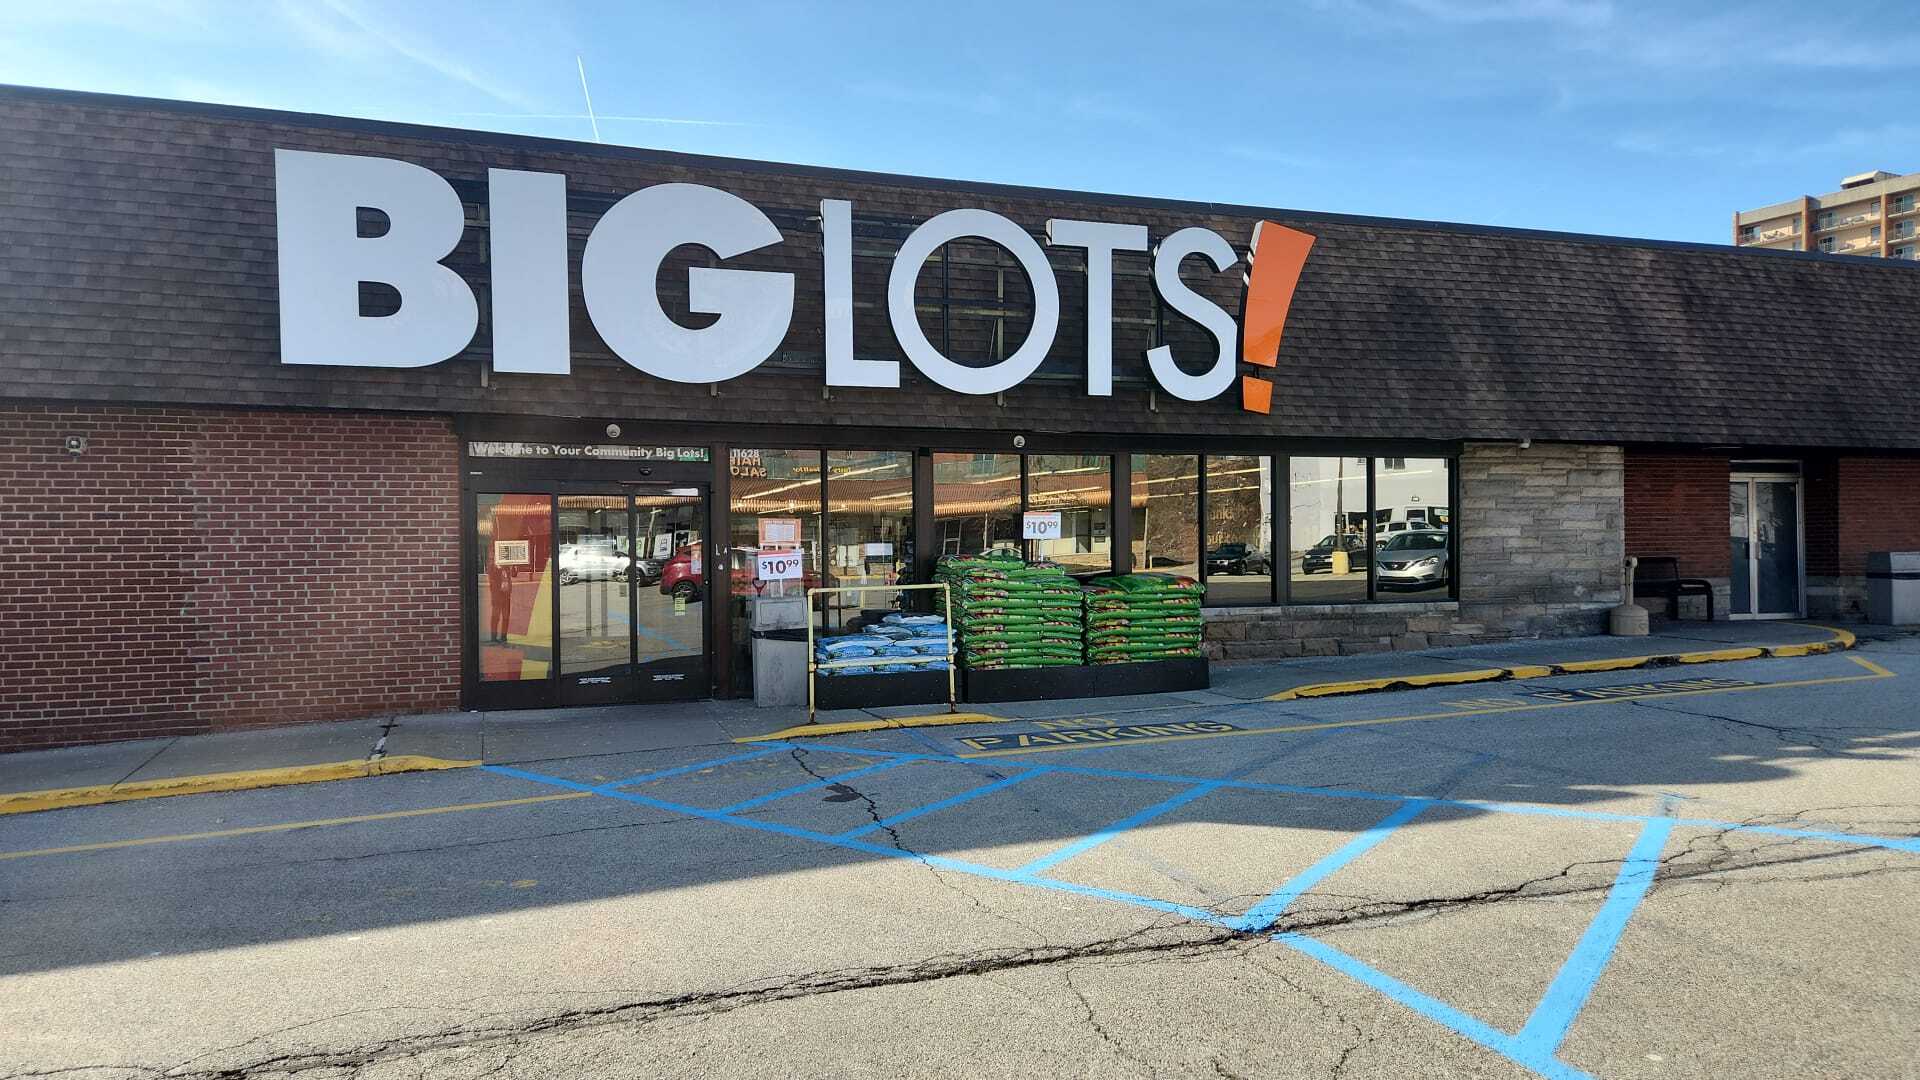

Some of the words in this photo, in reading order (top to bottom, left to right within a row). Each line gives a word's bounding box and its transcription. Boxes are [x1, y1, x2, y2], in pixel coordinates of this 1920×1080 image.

[275, 148, 796, 384] BIG
[820, 198, 1317, 415] LOTS!
[536, 445, 549, 455] to
[552, 445, 581, 456] Your
[584, 445, 652, 460] Community
[656, 447, 675, 460] Big
[677, 448, 704, 458] Lots!
[960, 721, 1234, 750] PARKING
